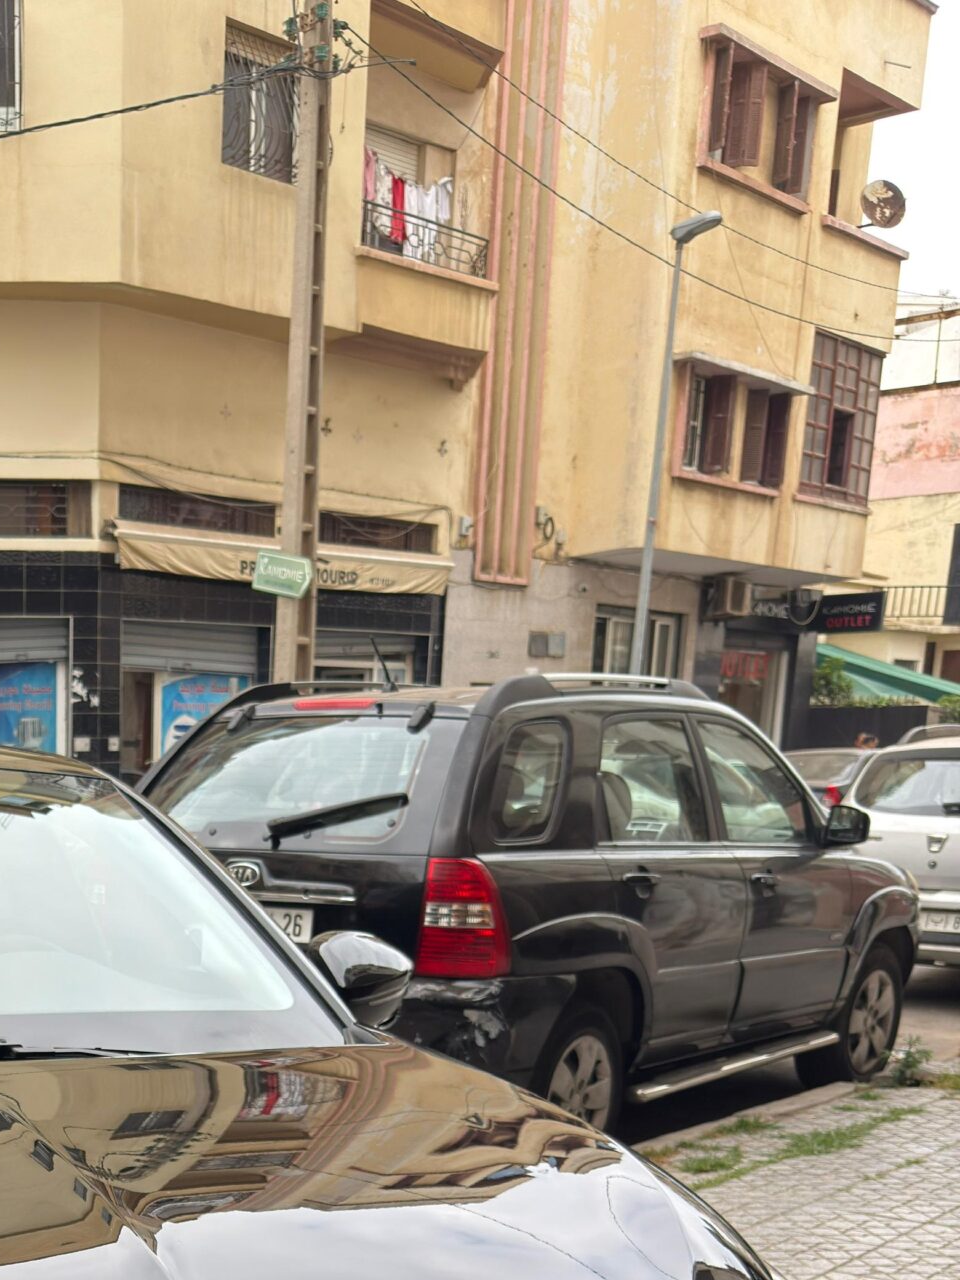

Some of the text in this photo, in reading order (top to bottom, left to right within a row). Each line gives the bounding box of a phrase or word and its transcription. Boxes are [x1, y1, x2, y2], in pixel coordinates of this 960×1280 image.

[826, 615, 872, 628] OUTLET
[229, 868, 254, 881] KIA
[284, 913, 303, 937] 26
